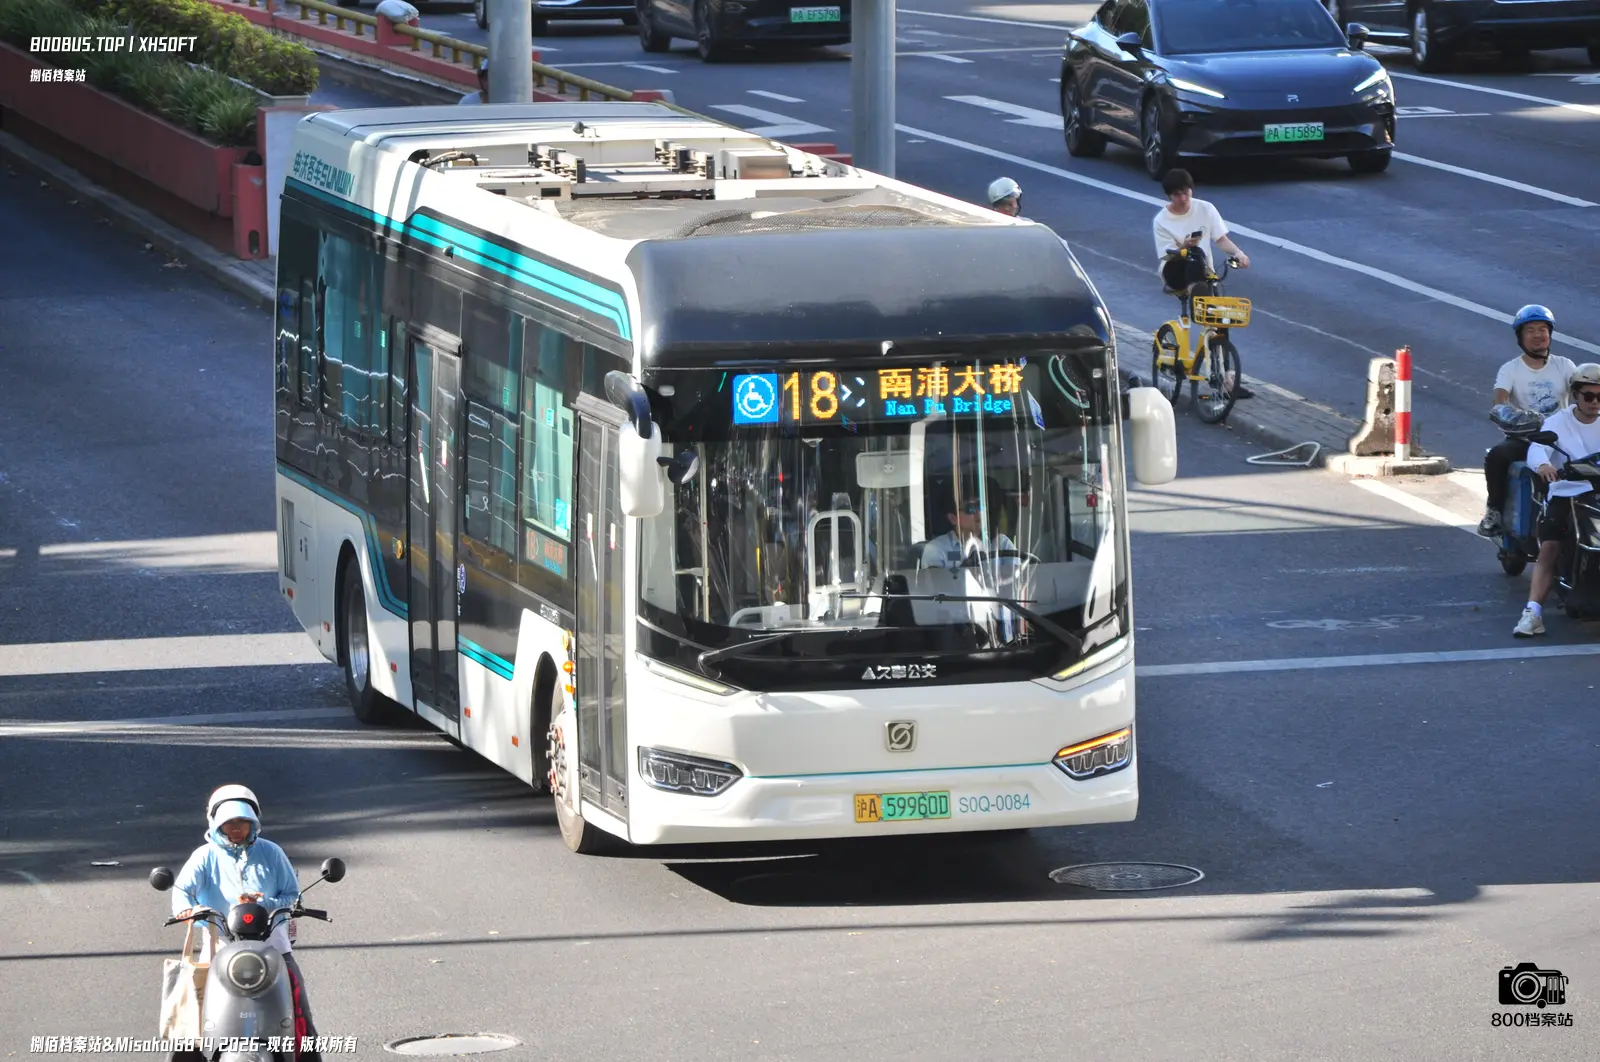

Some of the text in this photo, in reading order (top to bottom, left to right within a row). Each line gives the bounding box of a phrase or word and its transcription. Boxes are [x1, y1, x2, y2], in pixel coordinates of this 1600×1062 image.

[1284, 125, 1323, 139] ET5895
[878, 363, 1023, 400] 南浦大桥
[784, 371, 838, 420] 18
[885, 394, 1013, 416] Nan Pu Bridge
[857, 794, 949, 819] 沪A 59960D
